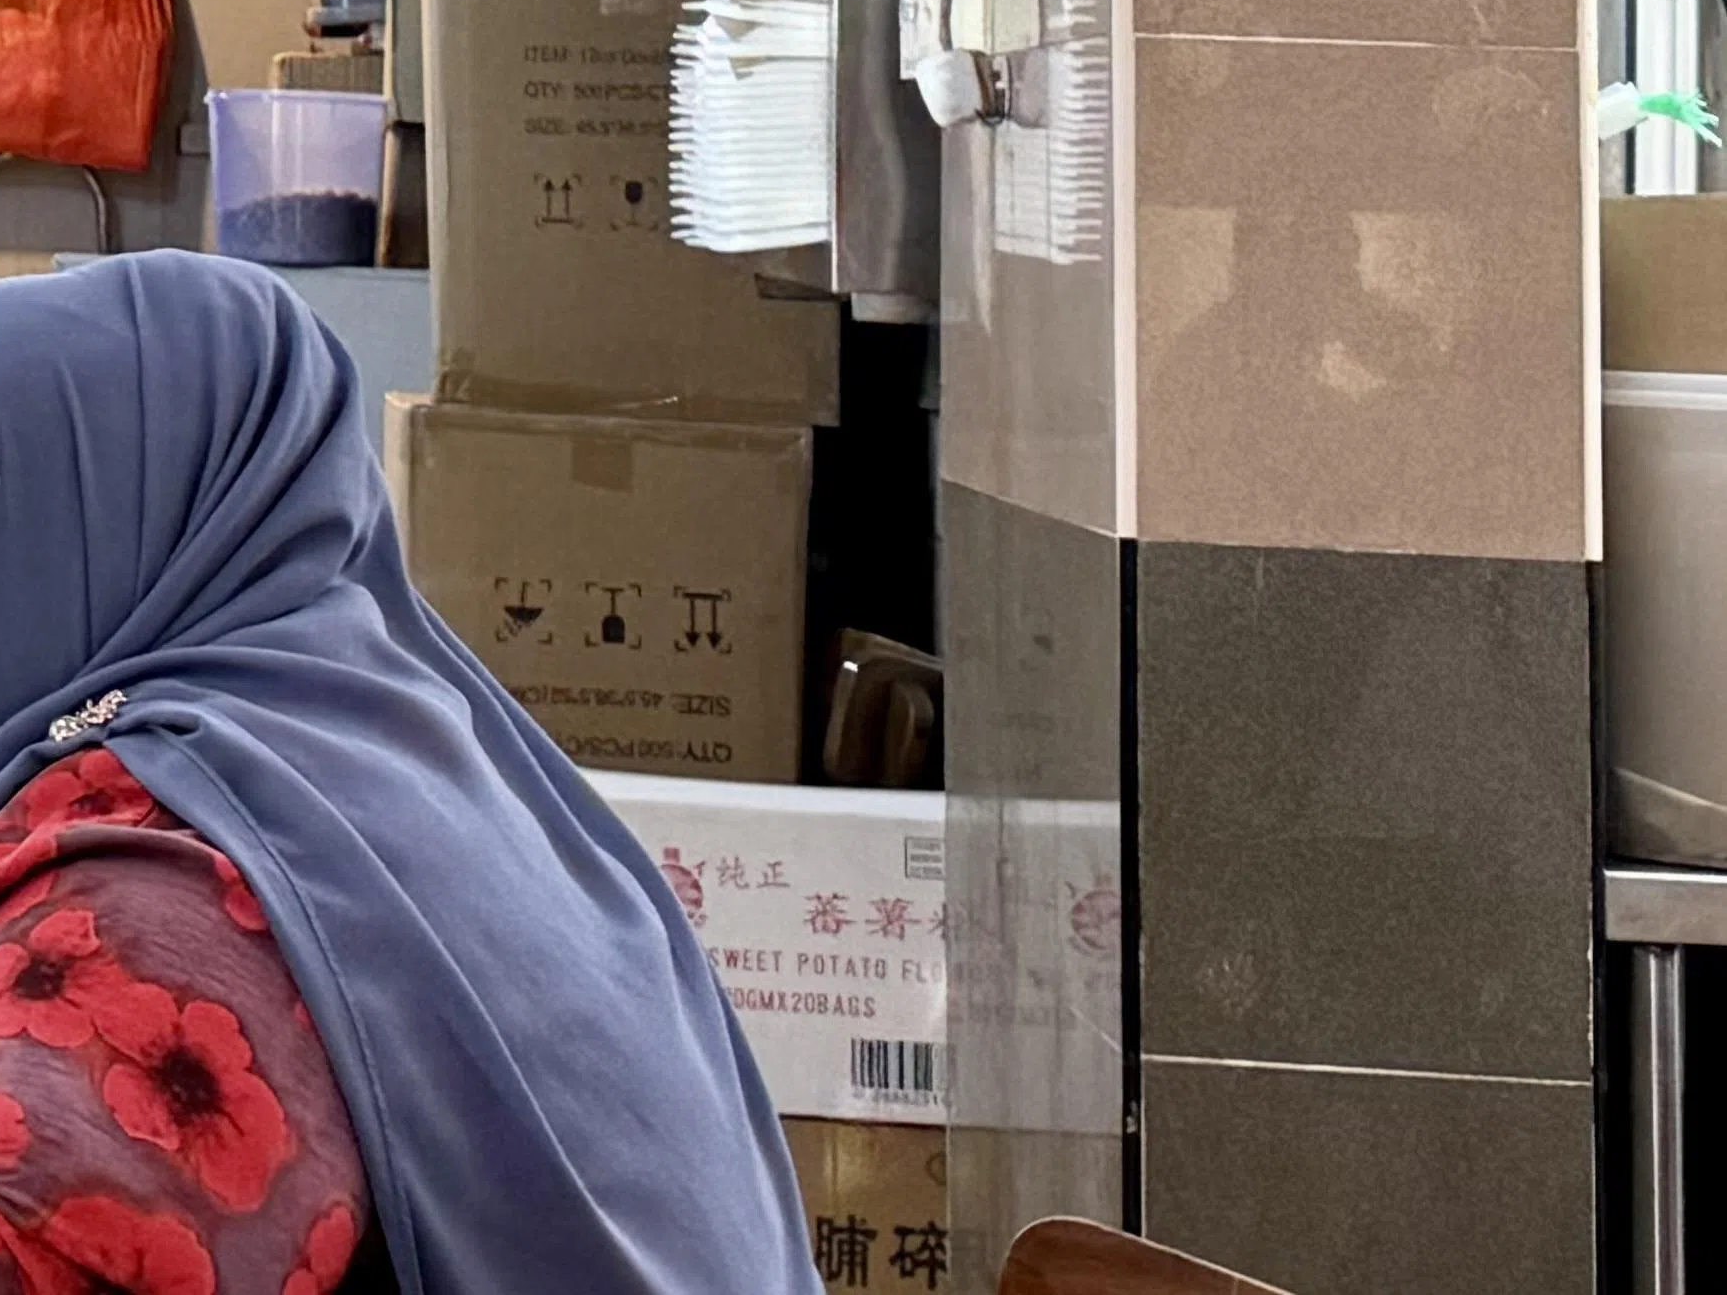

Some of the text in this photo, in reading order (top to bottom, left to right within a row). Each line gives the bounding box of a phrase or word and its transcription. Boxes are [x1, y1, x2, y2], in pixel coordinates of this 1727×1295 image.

[716, 857, 790, 889] 纯正
[709, 947, 887, 980] SWEET POTATO
